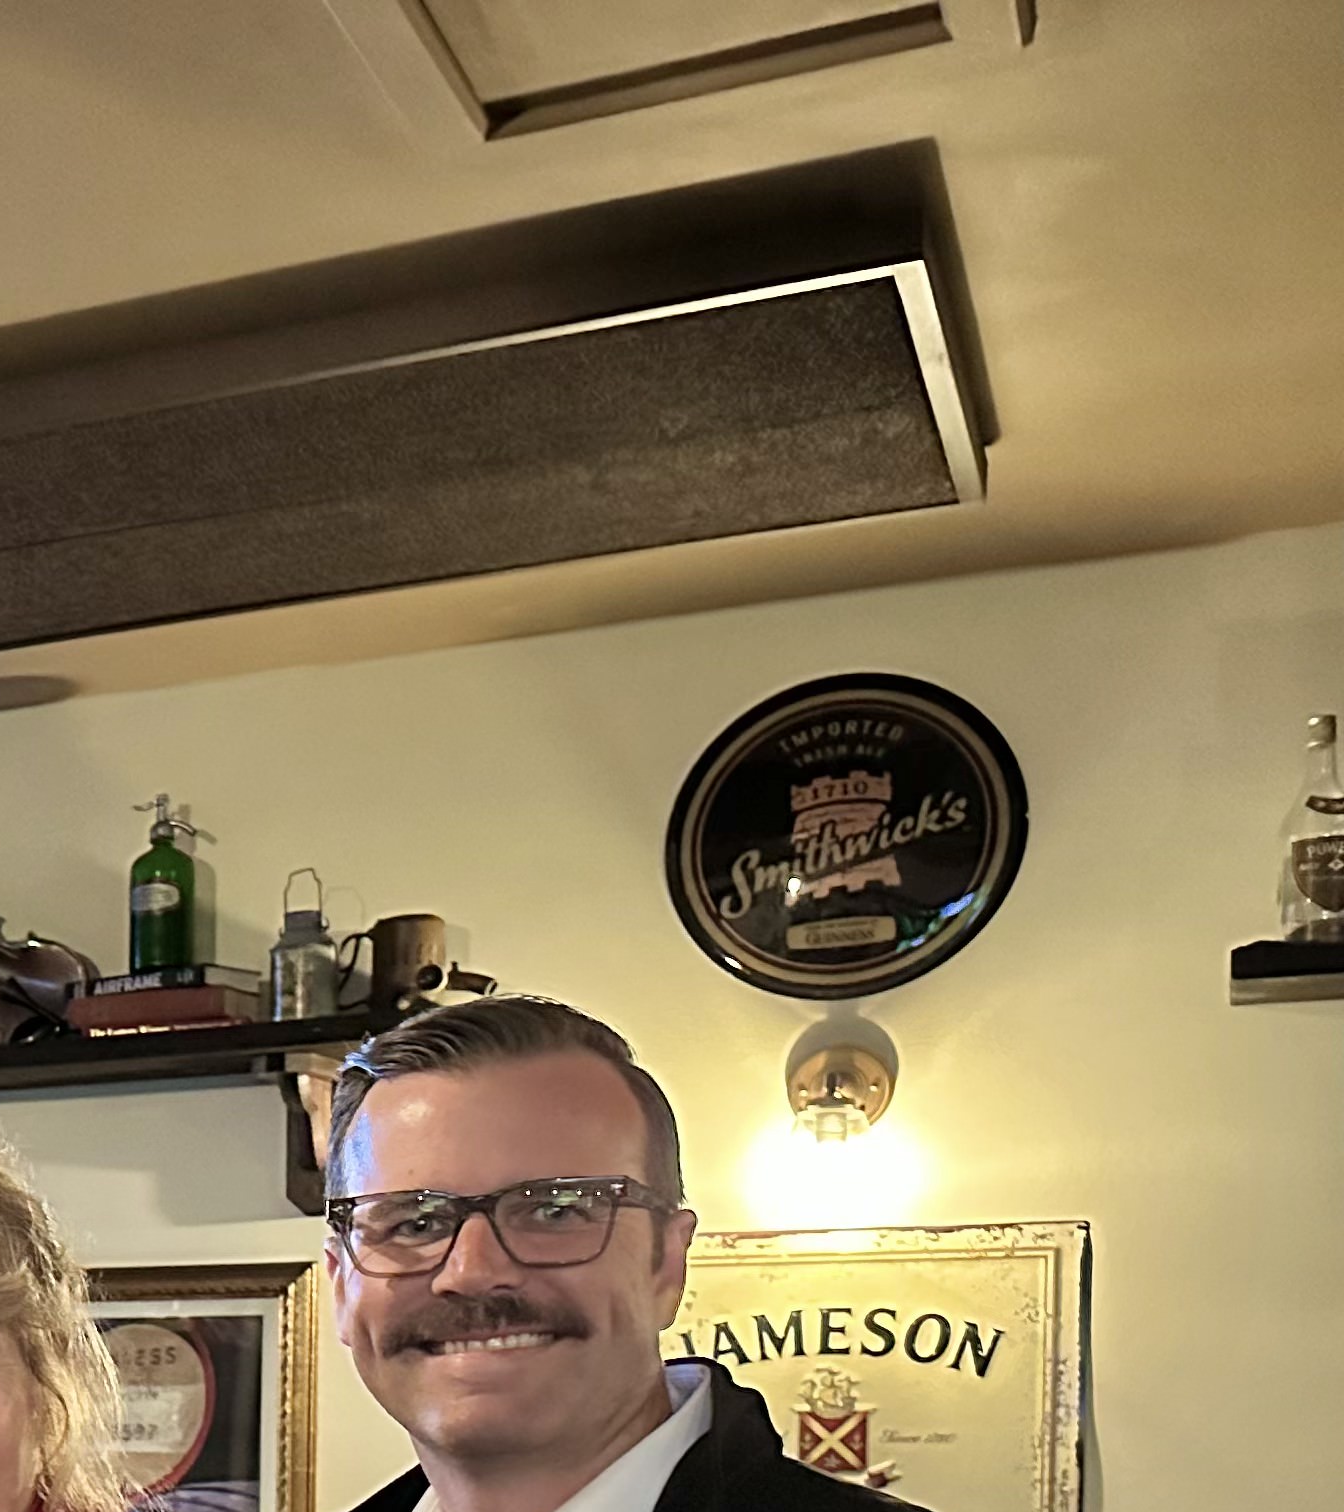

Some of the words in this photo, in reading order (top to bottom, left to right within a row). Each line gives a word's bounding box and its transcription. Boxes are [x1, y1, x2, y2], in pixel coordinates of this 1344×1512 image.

[778, 720, 905, 753] IMPORTED
[812, 780, 869, 799] 1710
[719, 790, 969, 920] Smithwick's
[1306, 841, 1344, 859] POWE
[94, 973, 162, 996] AIRFRAME
